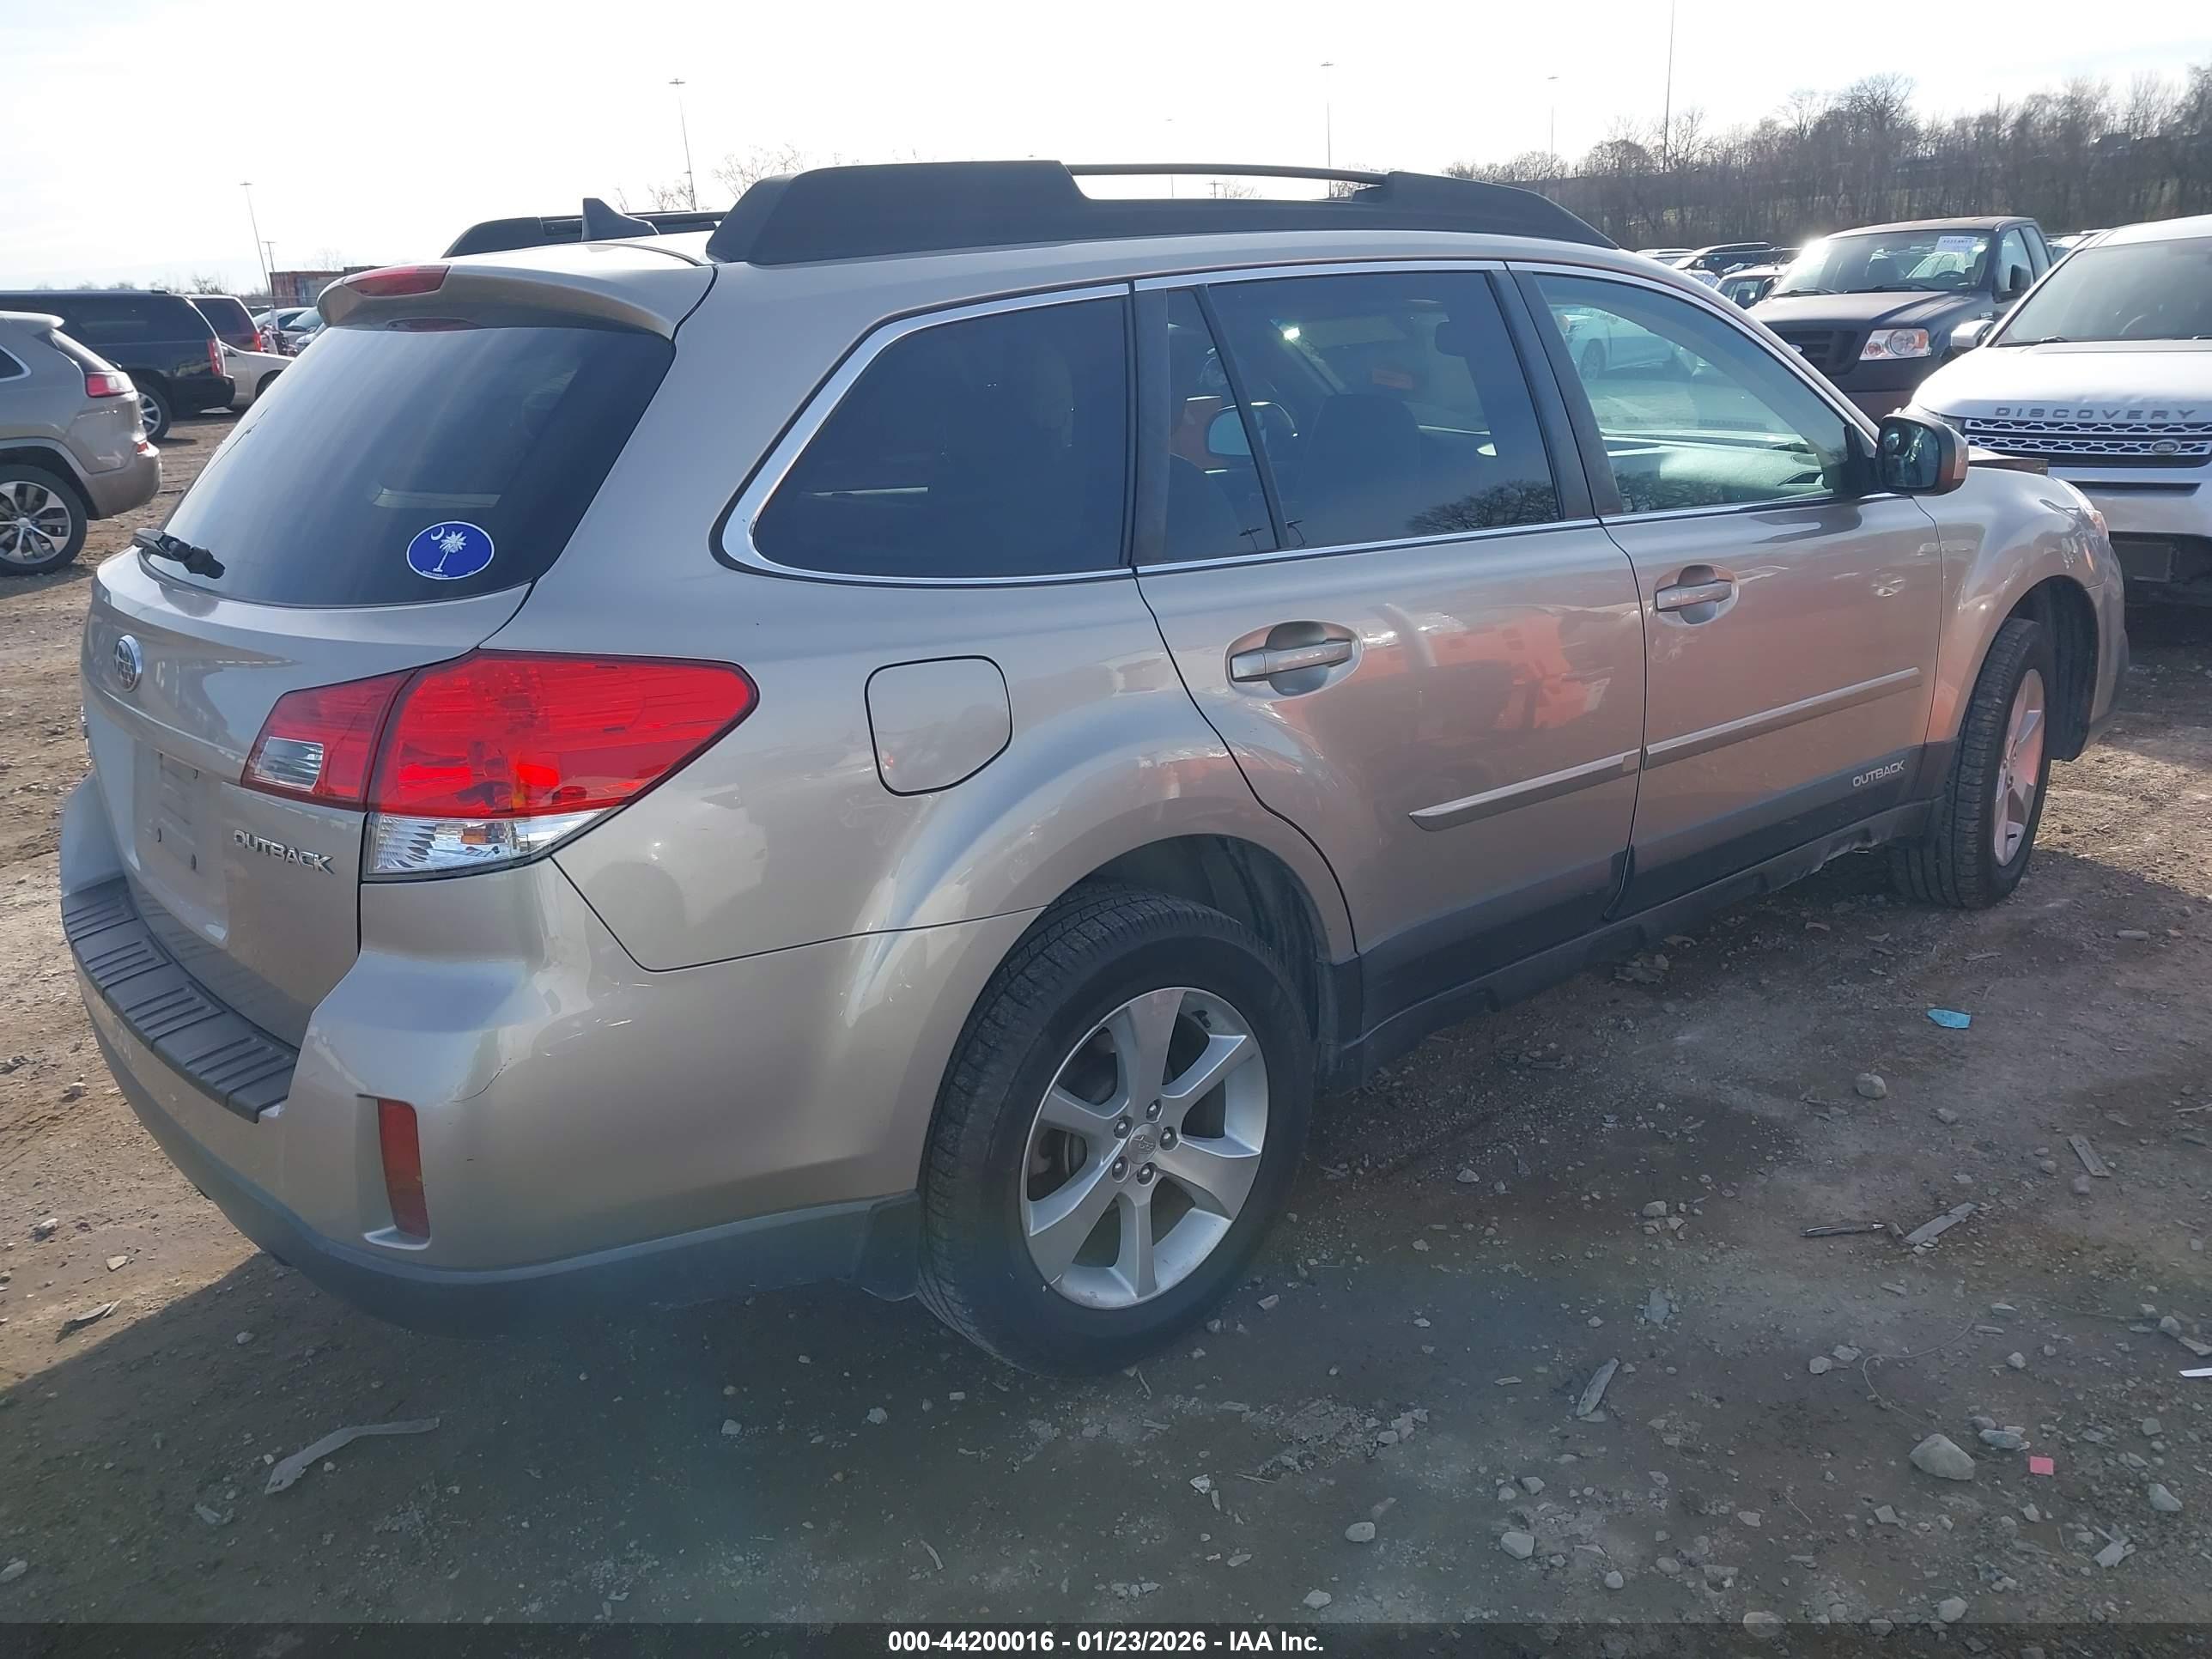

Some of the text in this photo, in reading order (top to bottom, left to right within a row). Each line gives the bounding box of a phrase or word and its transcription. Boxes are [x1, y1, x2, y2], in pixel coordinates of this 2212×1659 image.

[1995, 407, 2197, 420] DISCOVERY
[1852, 759, 1905, 787] OUTBACK
[234, 830, 335, 875] OUTBACK
